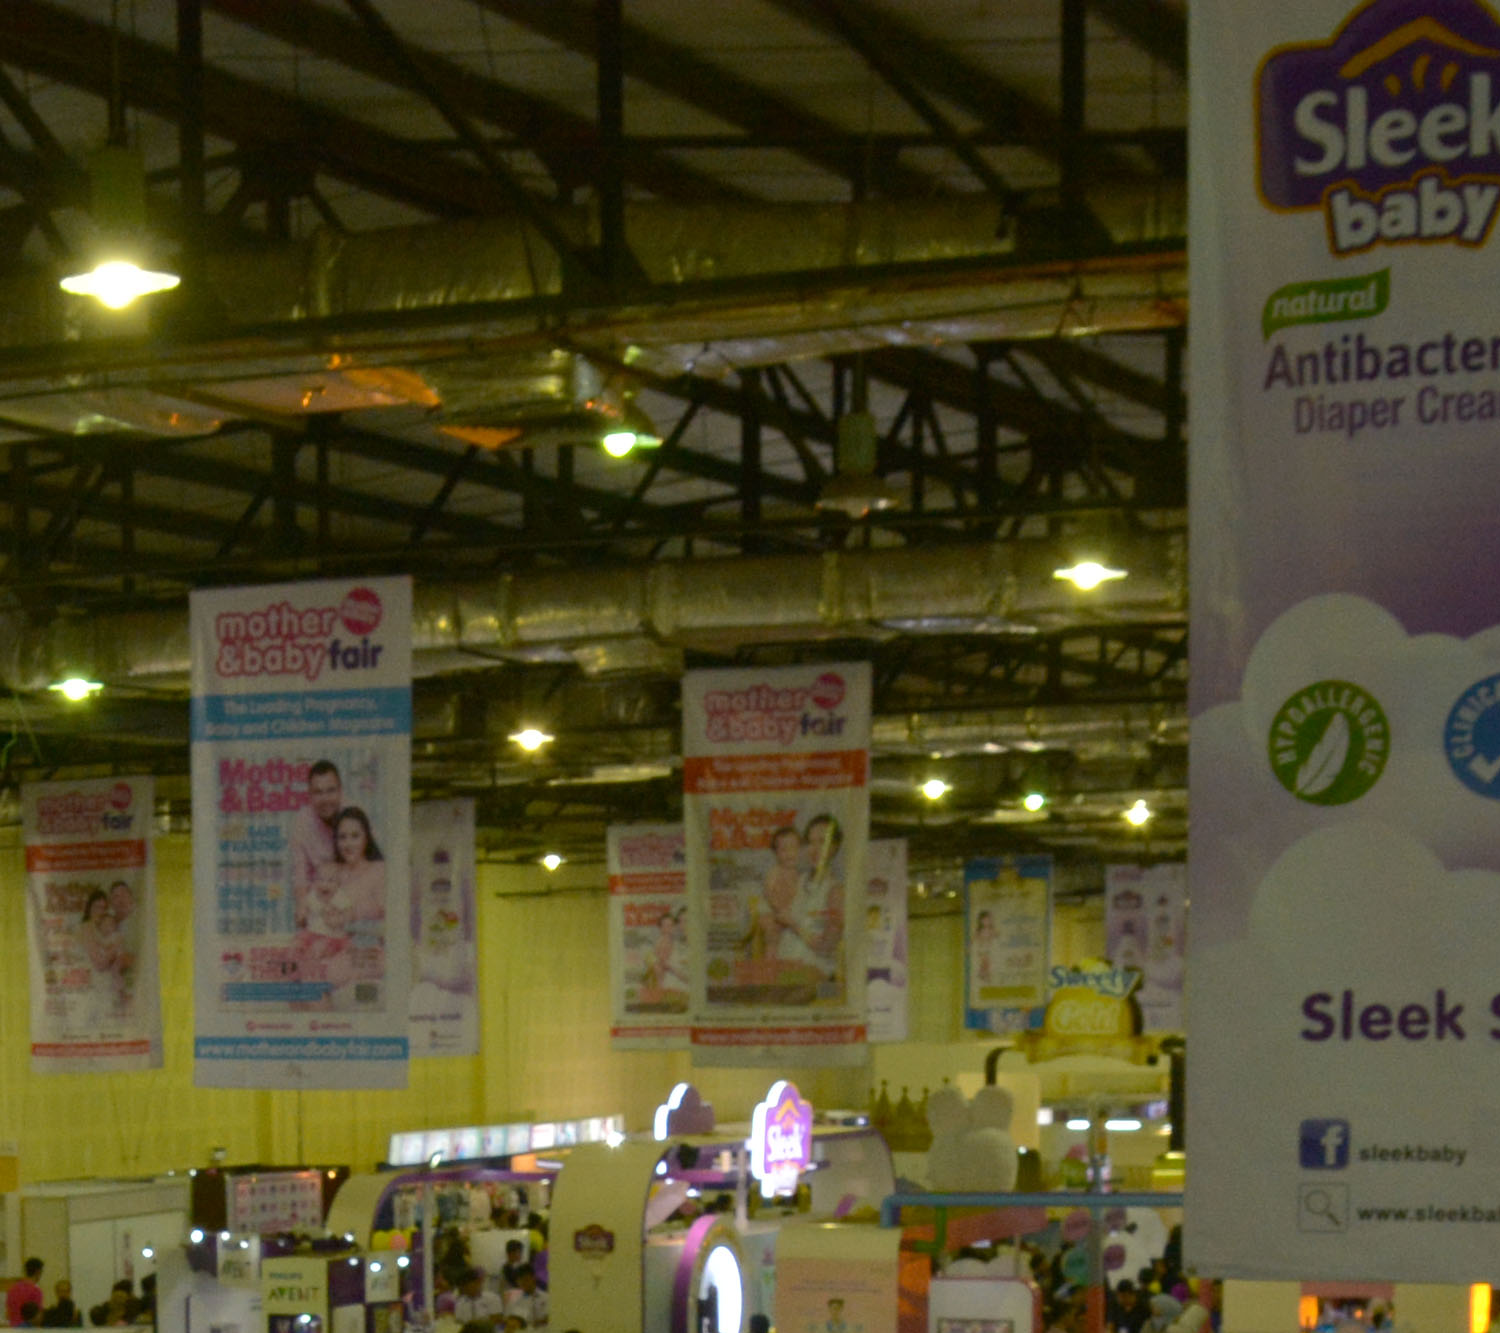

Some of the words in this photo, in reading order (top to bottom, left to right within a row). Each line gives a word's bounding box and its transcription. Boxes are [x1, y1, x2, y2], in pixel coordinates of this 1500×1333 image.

[1270, 281, 1378, 320] natural
[1294, 389, 1404, 437] Diaper
[216, 603, 336, 642] mother
[218, 639, 328, 678] &baby
[329, 635, 383, 670] fair
[800, 710, 845, 736] fair
[1272, 684, 1388, 776] HYPOALLERGENIC
[1301, 991, 1465, 1044] Sleek
[1359, 1143, 1467, 1168] sleekbaby
